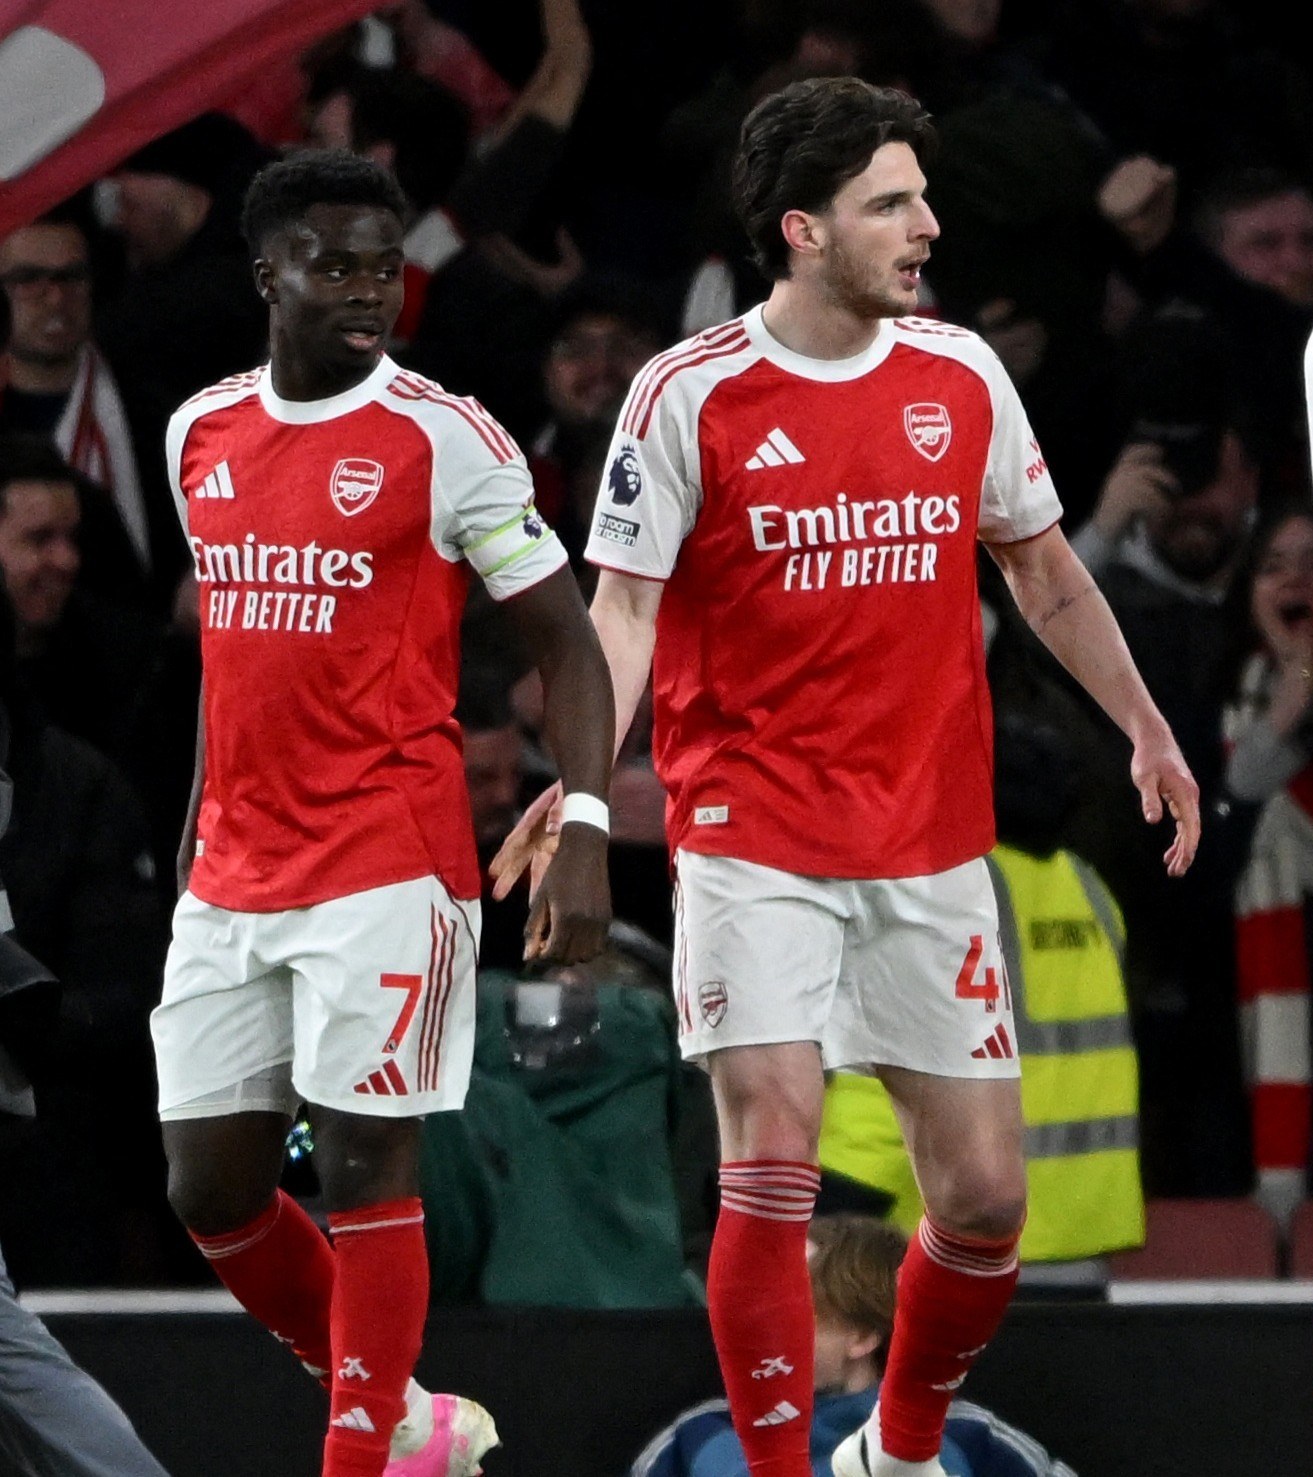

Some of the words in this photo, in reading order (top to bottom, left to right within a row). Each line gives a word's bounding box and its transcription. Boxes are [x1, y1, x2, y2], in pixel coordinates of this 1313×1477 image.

[911, 413, 944, 423] Arsenal
[340, 467, 378, 480] Arsenal
[606, 517, 634, 535] room
[746, 490, 961, 552] Emirates
[190, 533, 374, 588] Emirates
[784, 551, 832, 591] FLY
[841, 542, 938, 588] BETTER
[208, 590, 238, 629] FLY
[242, 591, 336, 633] BETTER
[955, 934, 999, 1013] 4
[380, 973, 422, 1053] 7
